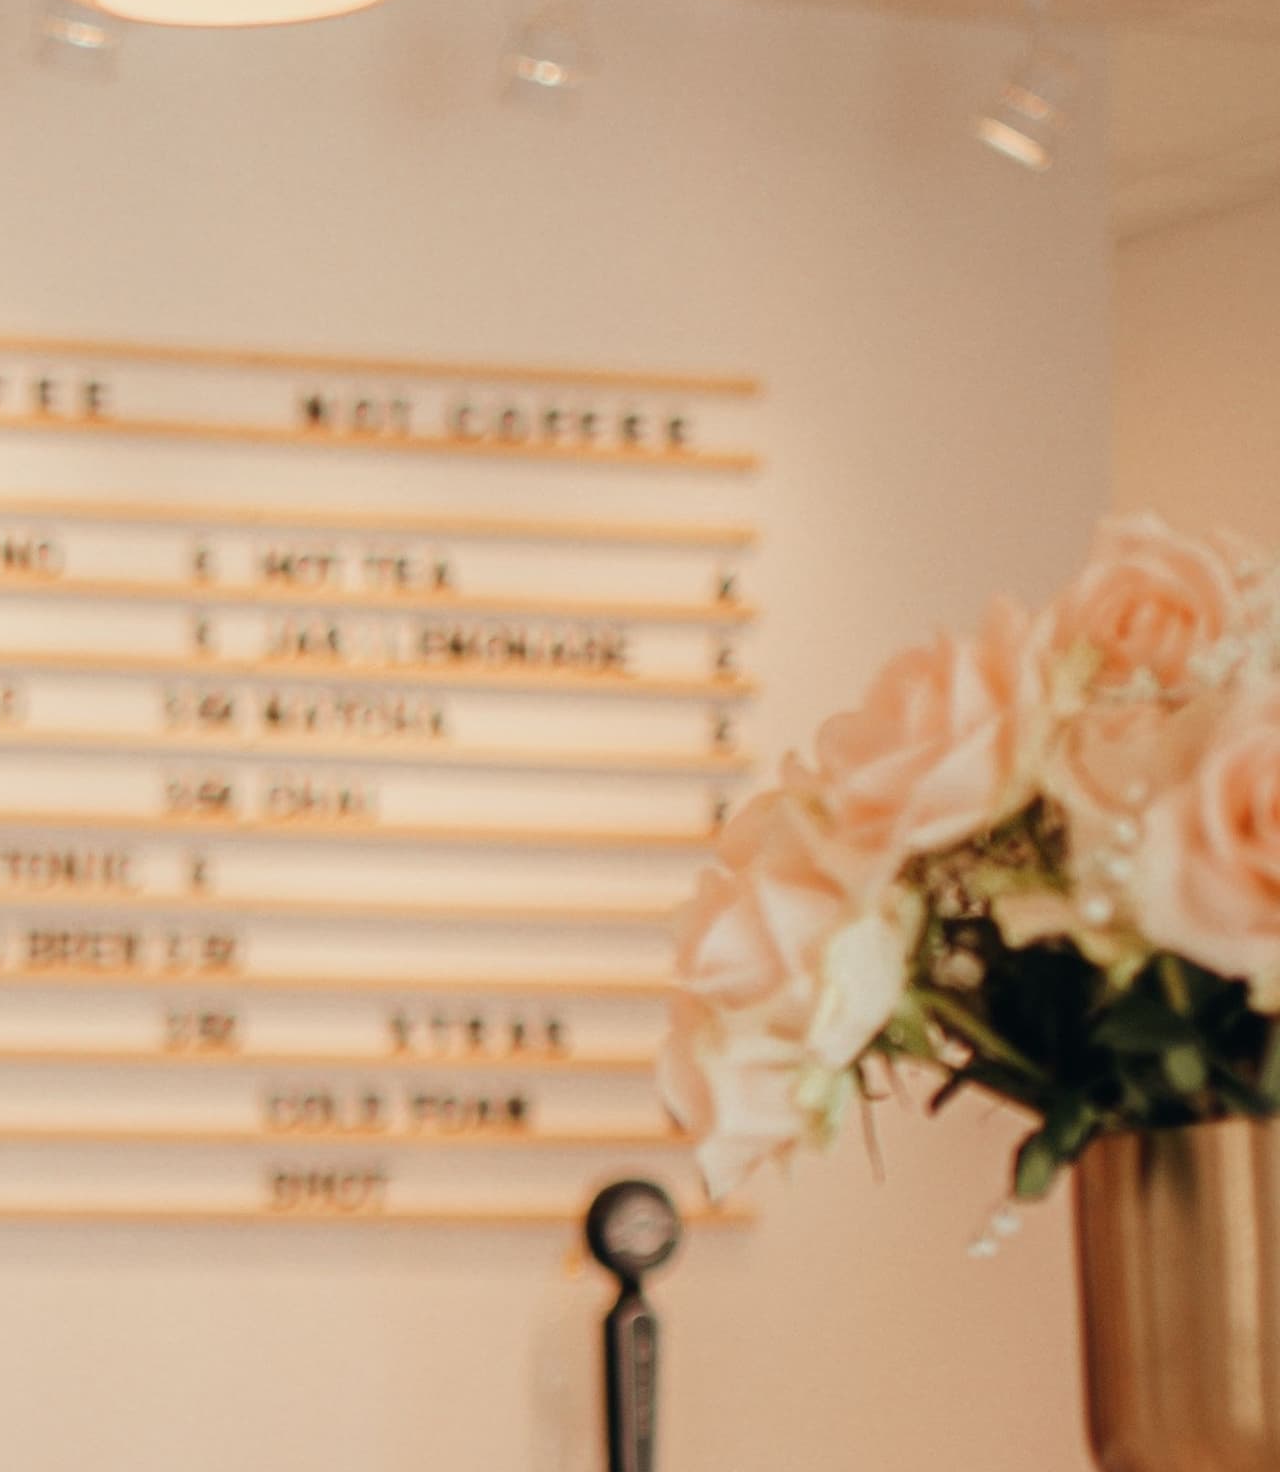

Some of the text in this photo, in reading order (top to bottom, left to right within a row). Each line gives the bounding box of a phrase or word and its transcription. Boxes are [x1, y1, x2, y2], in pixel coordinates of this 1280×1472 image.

[300, 392, 690, 450] NOT COFFEE
[359, 552, 450, 592] TEA
[0, 844, 137, 892] TONIC
[22, 928, 144, 974] BREW
